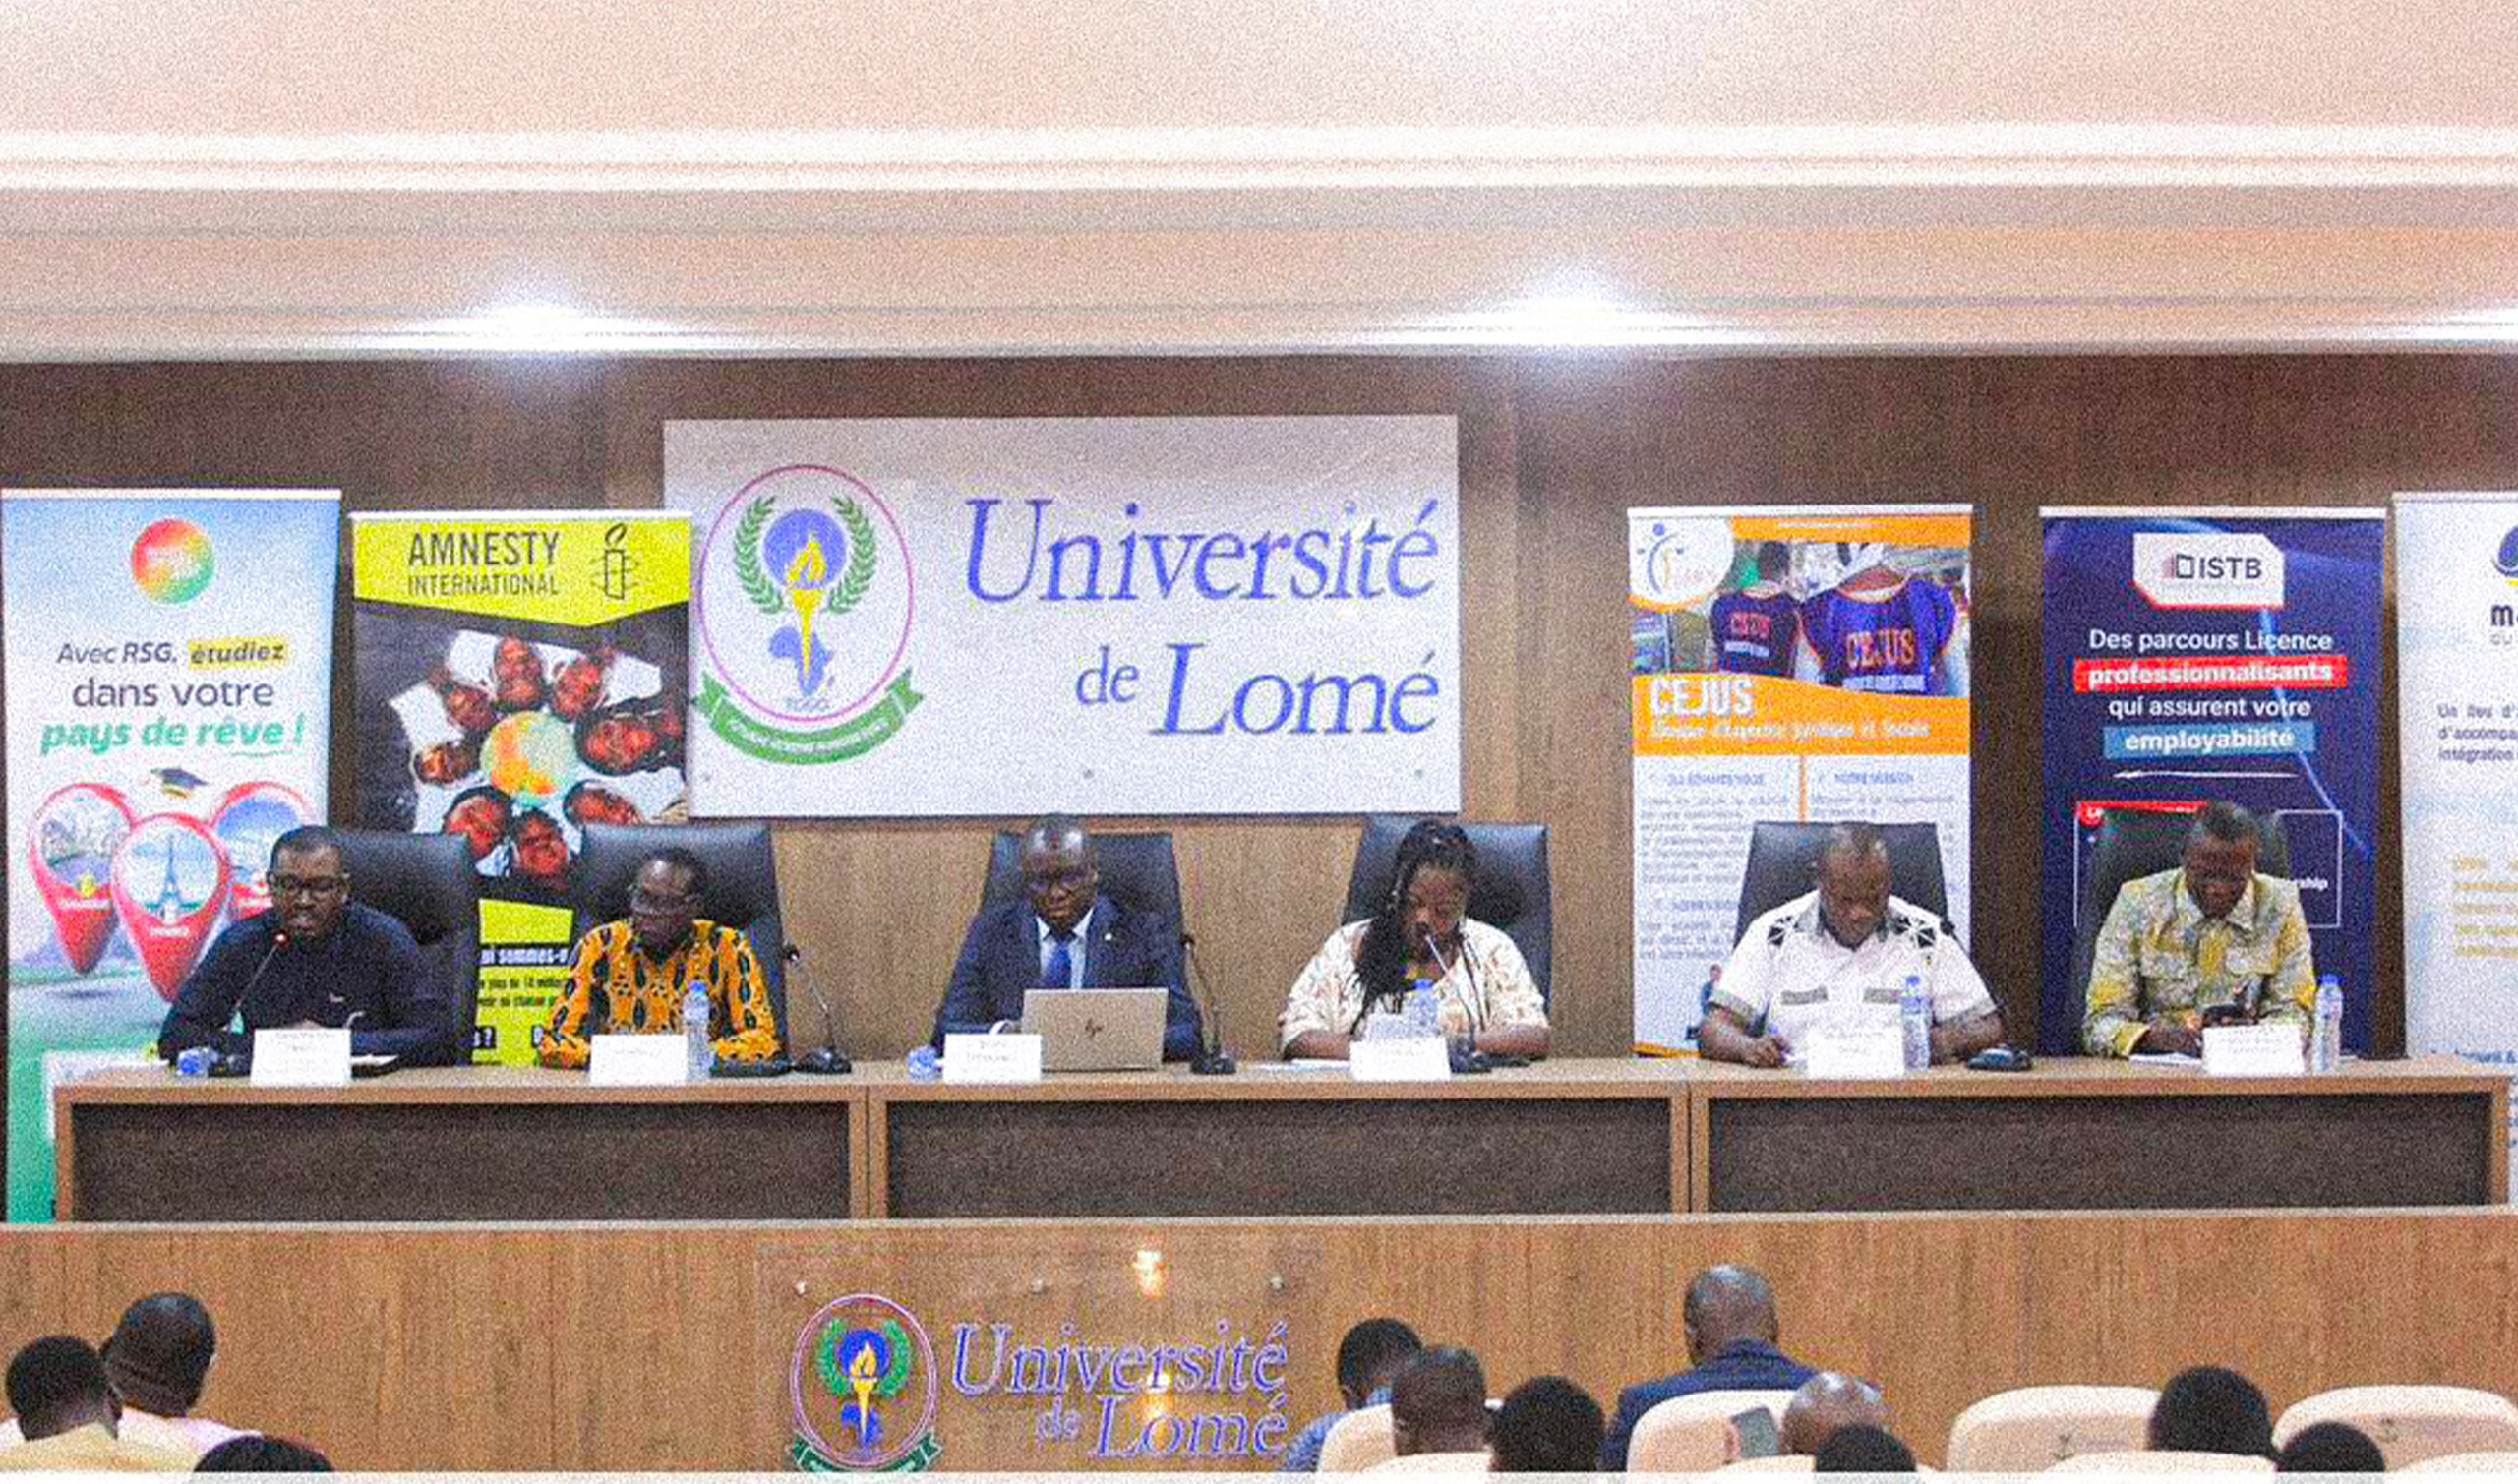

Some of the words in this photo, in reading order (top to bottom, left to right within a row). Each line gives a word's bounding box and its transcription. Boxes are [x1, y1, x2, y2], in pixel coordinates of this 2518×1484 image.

[408, 532, 560, 566] AMNESTY
[964, 497, 1439, 602] Université
[407, 574, 560, 597] INTERNATIONAL
[56, 643, 116, 665] Avec
[190, 641, 284, 665] étudiez
[1846, 628, 1915, 669] CEJUS
[2089, 629, 2132, 650] Des
[2139, 633, 2239, 653] parcours
[2245, 630, 2334, 652] Licence
[72, 677, 160, 708] dans
[171, 683, 275, 708] votre
[1076, 646, 1140, 705] de
[1151, 642, 1440, 737] Lomé
[2088, 660, 2333, 691] professionnalisants
[1649, 678, 1754, 717] CEJUS
[2108, 695, 2144, 720] qui
[2149, 698, 2247, 718] assurent
[2253, 699, 2311, 718] votre
[39, 721, 131, 756] pays
[143, 714, 188, 746] de
[197, 716, 285, 747] rêve
[2125, 728, 2296, 758] employabilité
[951, 1318, 1288, 1396] Université
[1086, 1392, 1288, 1458] Lomé
